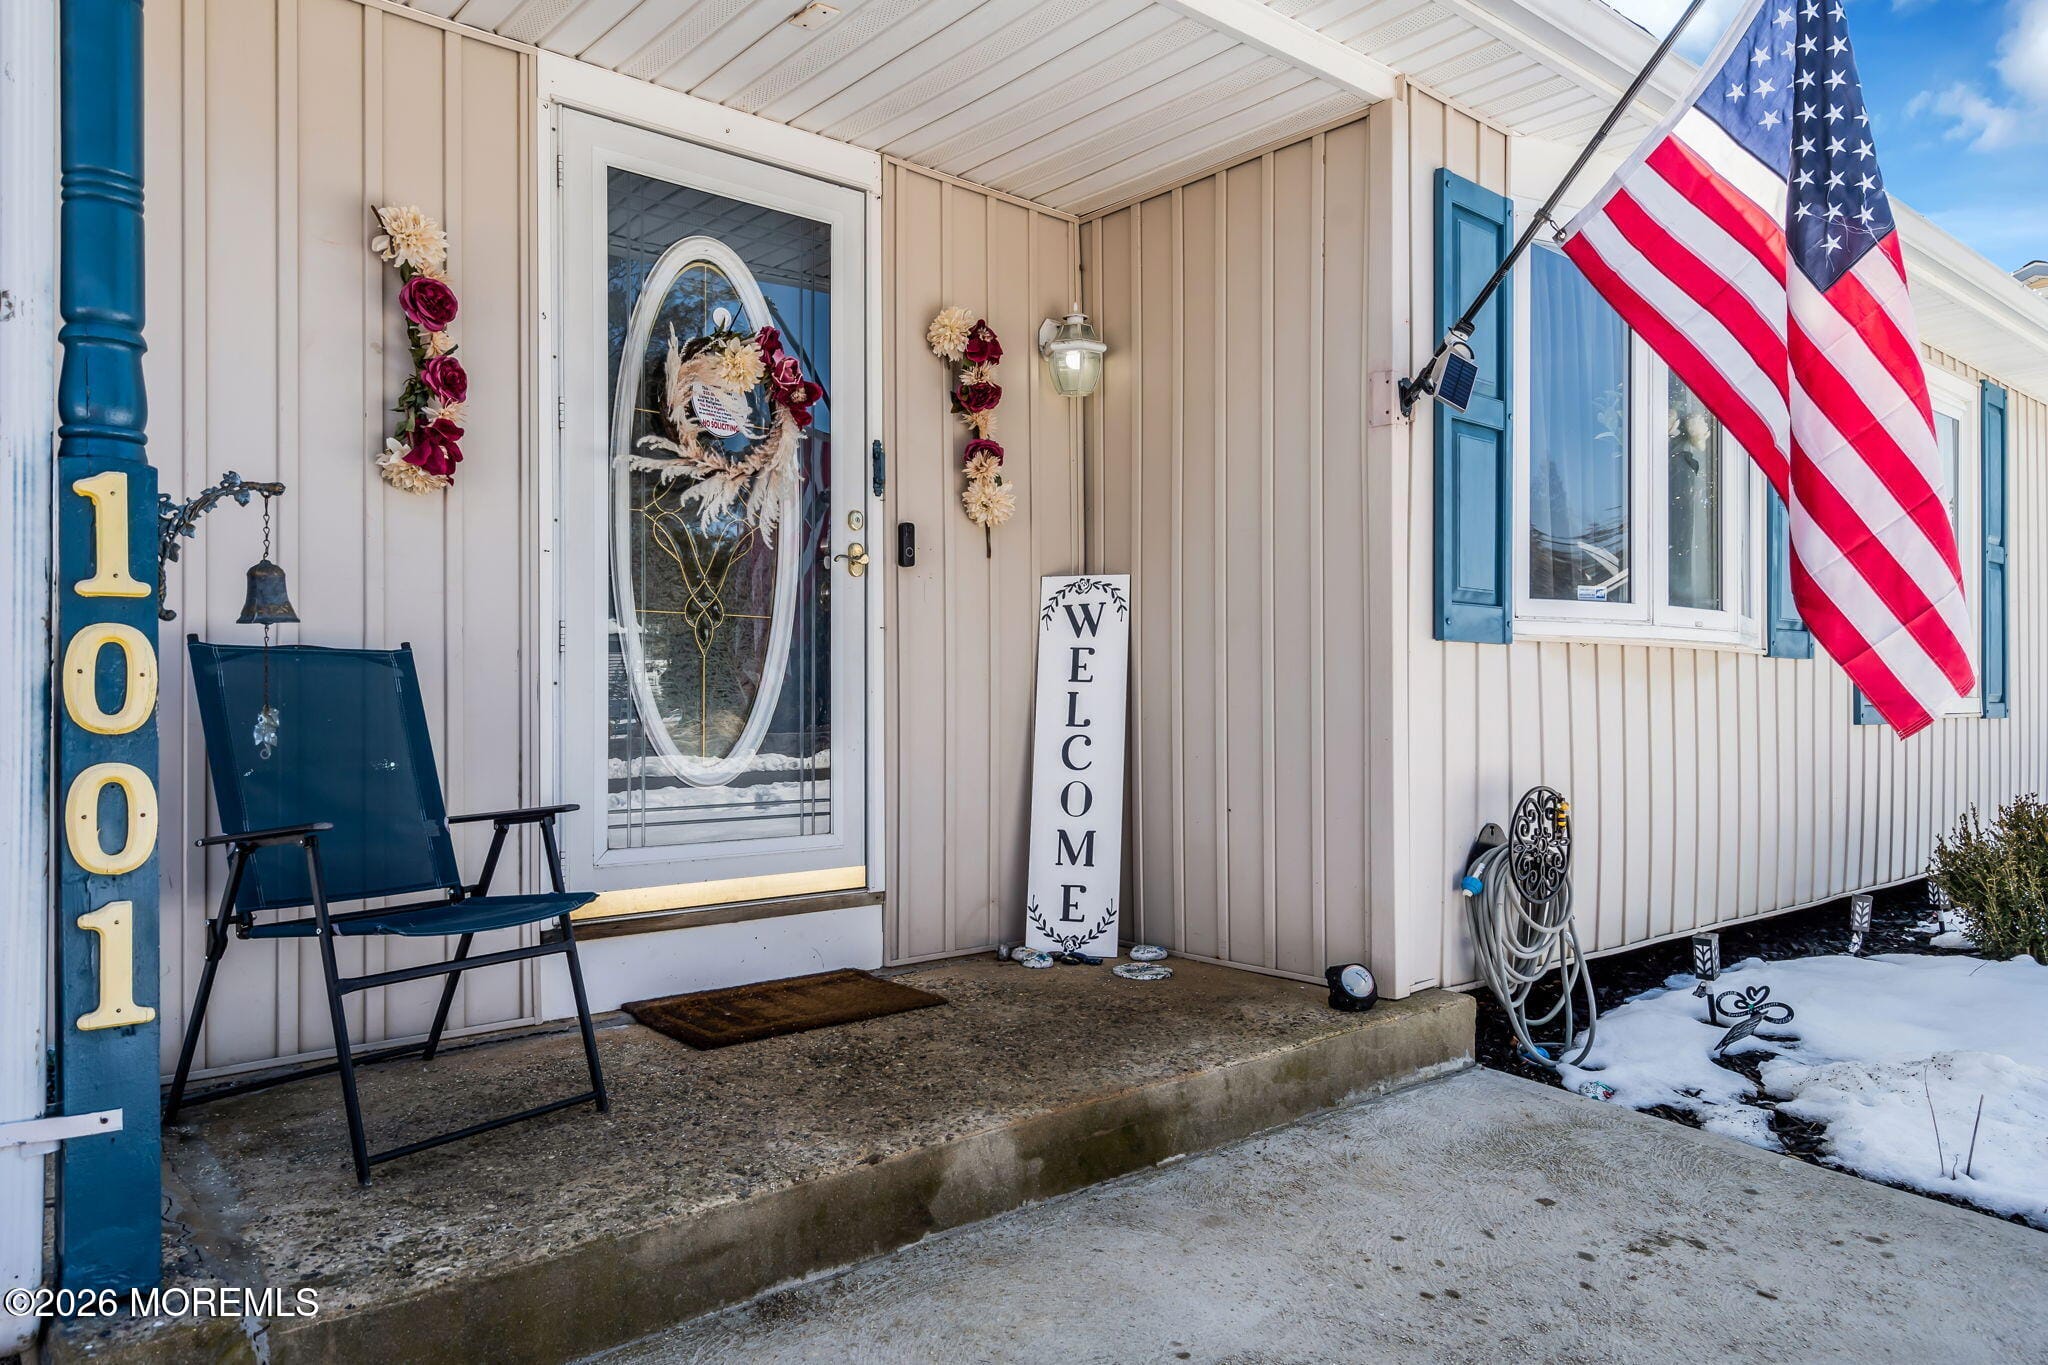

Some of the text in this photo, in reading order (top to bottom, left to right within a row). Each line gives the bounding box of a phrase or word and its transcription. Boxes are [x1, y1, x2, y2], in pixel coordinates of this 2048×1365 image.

[701, 418, 710, 427] NO
[62, 471, 158, 1031] 1001
[1055, 601, 1107, 923] WELCOME
